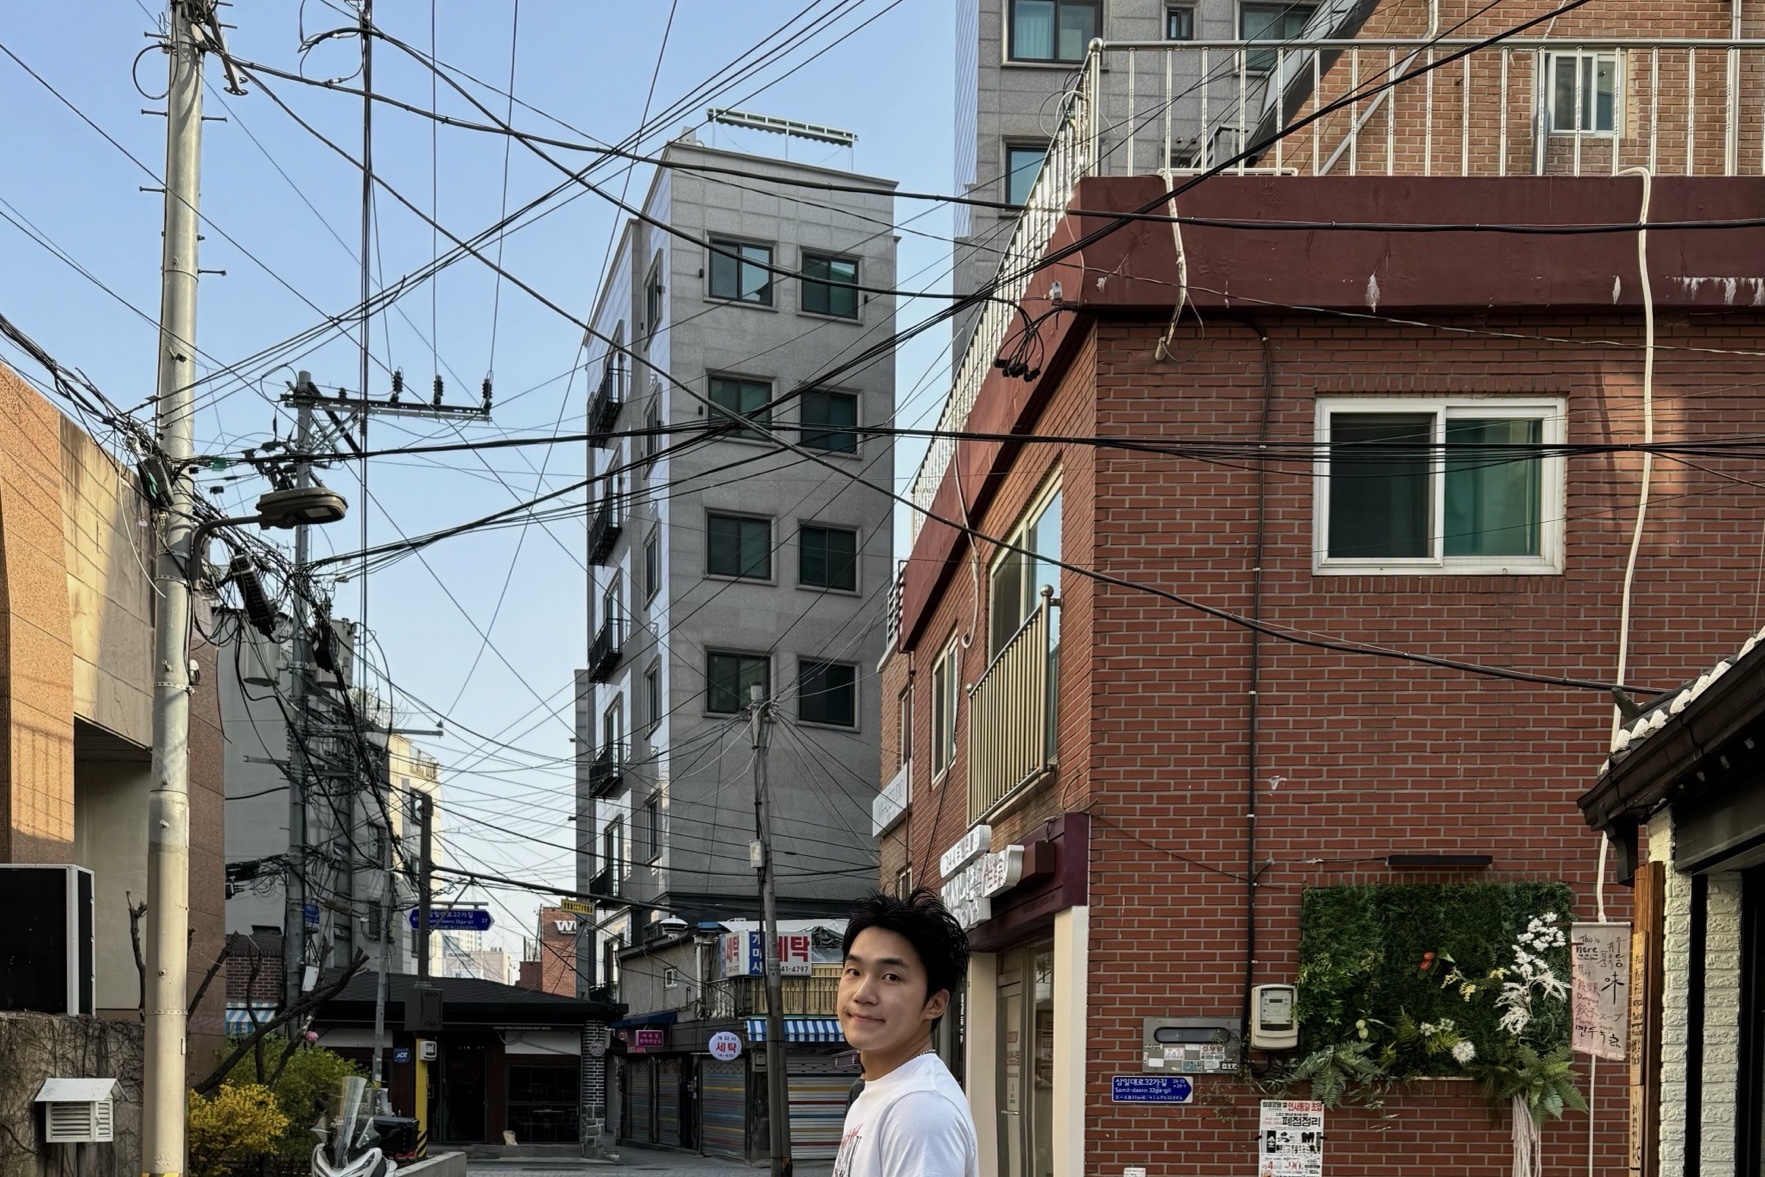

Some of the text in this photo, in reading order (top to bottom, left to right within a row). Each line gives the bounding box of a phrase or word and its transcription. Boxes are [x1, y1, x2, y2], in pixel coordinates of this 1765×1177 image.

[780, 965, 809, 973] 41-4797
[715, 1042, 737, 1053] 세탁
[1115, 1078, 1167, 1087] 삼일대로32가길
[1282, 1116, 1321, 1127] 폐점정리
